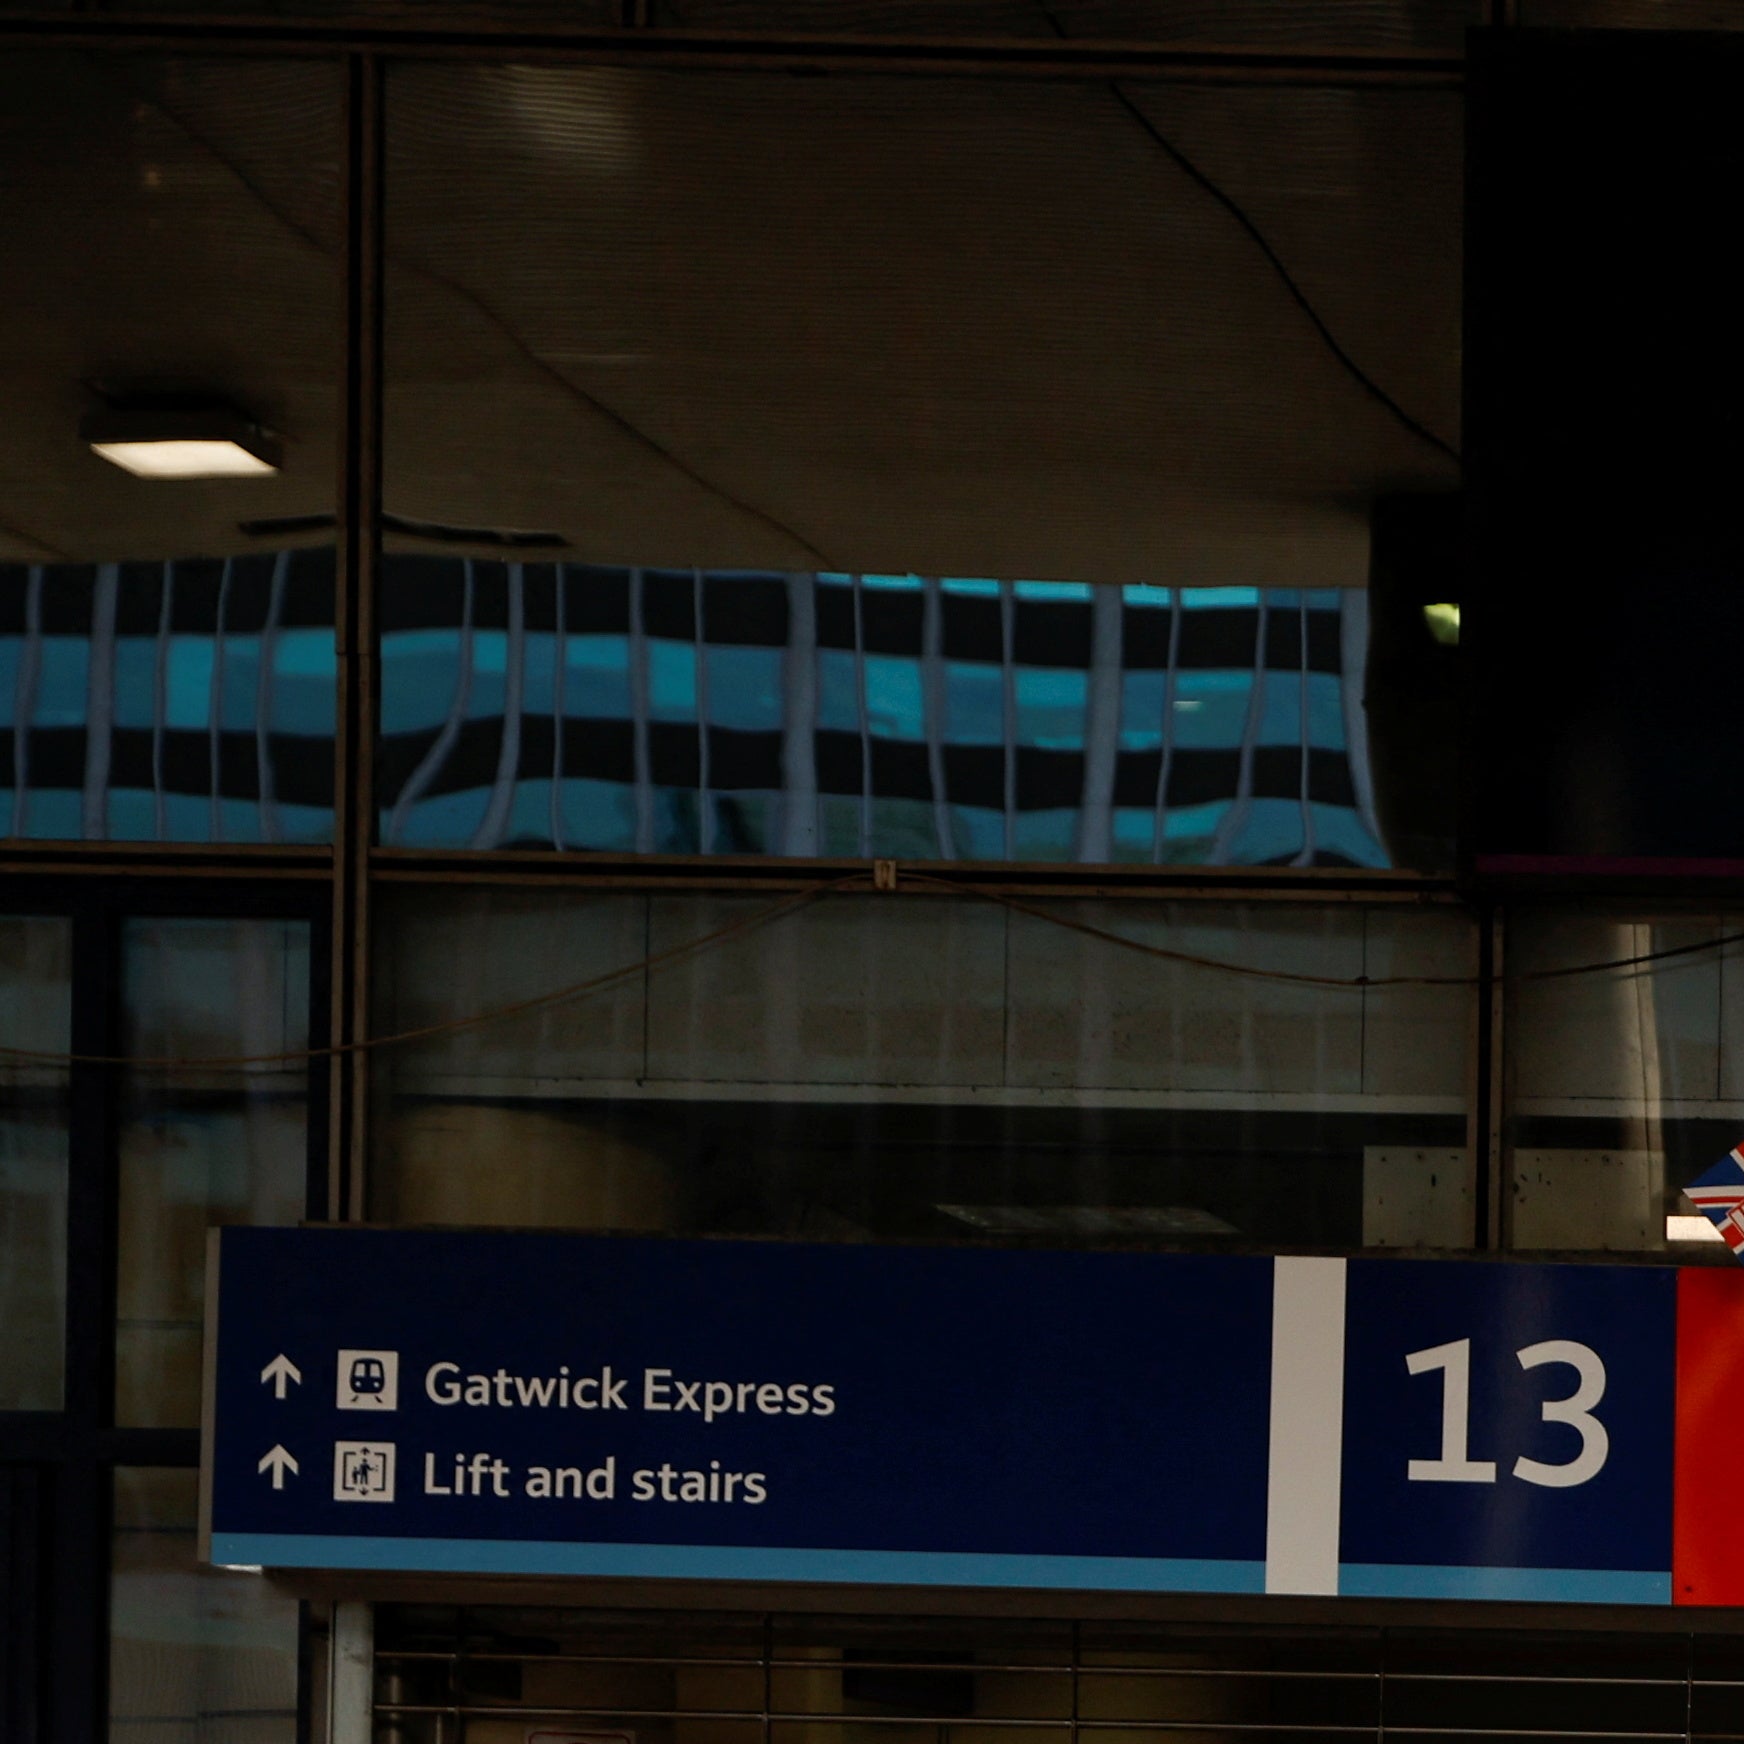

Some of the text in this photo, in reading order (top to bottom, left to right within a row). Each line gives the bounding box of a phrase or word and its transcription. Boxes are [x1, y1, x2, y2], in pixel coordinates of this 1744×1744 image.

[424, 1361, 837, 1423] Gatwick Express
[1404, 1337, 1610, 1488] 13
[423, 1452, 768, 1504] Lift and stairs
